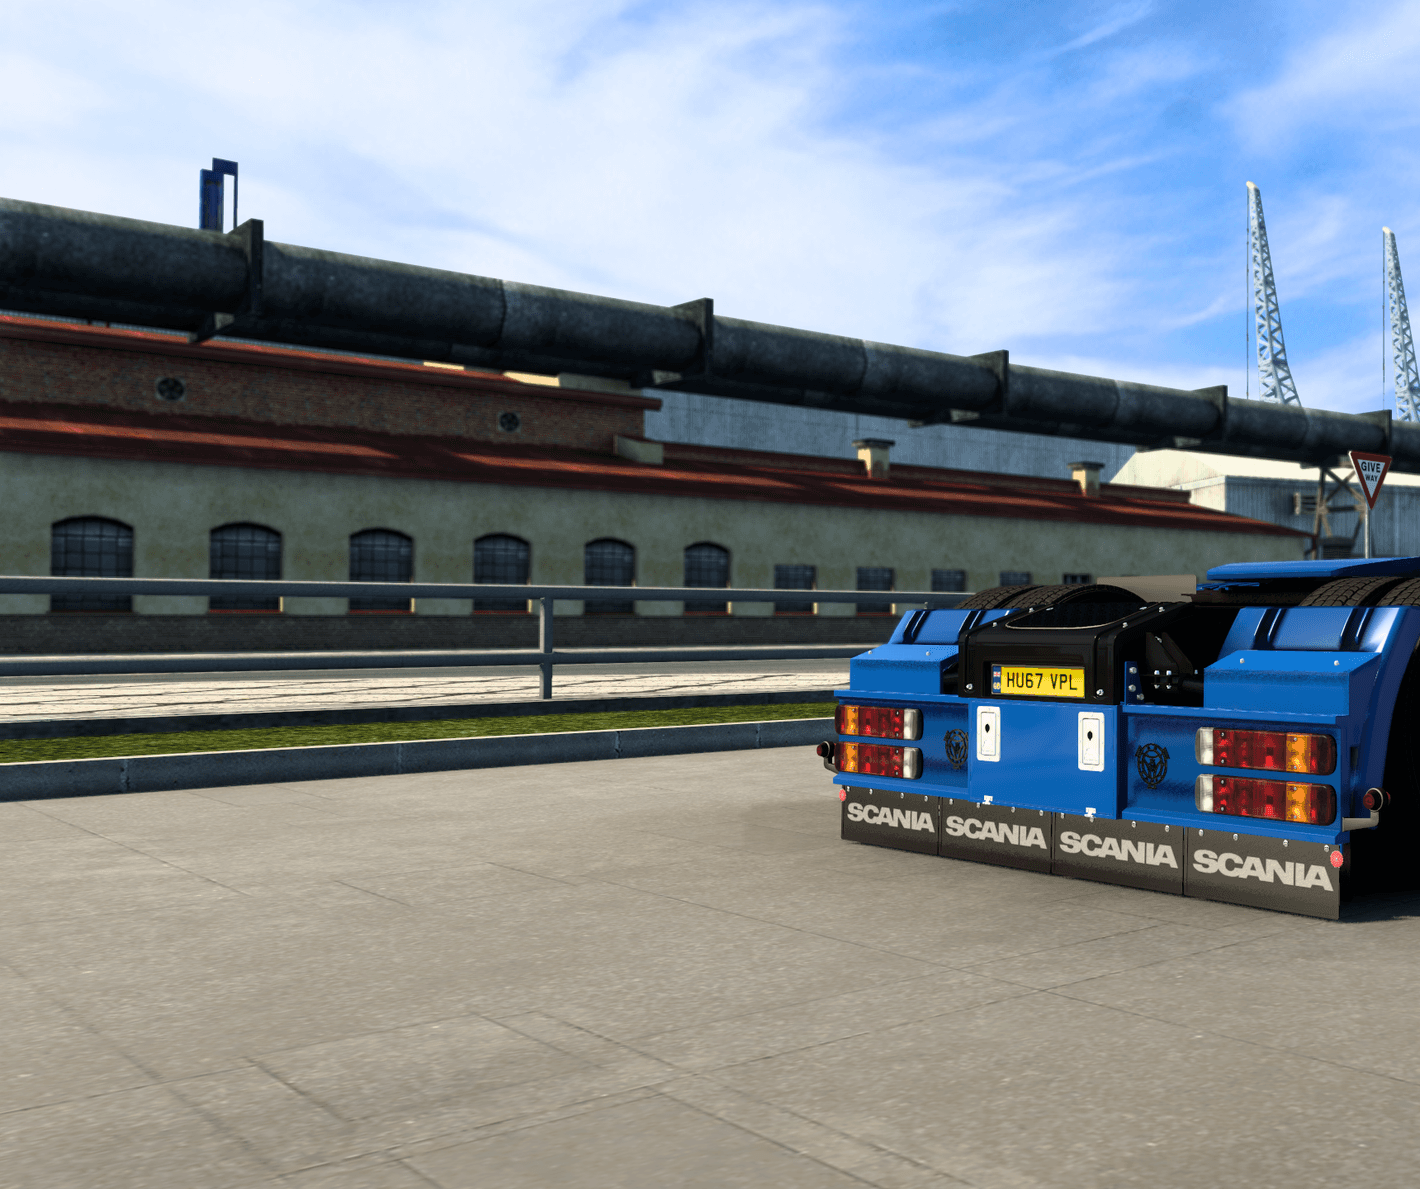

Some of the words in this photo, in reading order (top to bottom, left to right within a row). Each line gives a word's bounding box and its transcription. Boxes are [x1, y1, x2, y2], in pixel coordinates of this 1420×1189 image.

[1361, 461, 1381, 473] GIVE
[1365, 474, 1379, 482] WAY
[1007, 672, 1043, 689] HU67
[1050, 673, 1078, 690] VPL
[847, 802, 935, 833] SCANIA
[945, 816, 1047, 849] SCANIA
[1059, 831, 1178, 869] SCANIA
[1192, 849, 1334, 891] SCANIA
